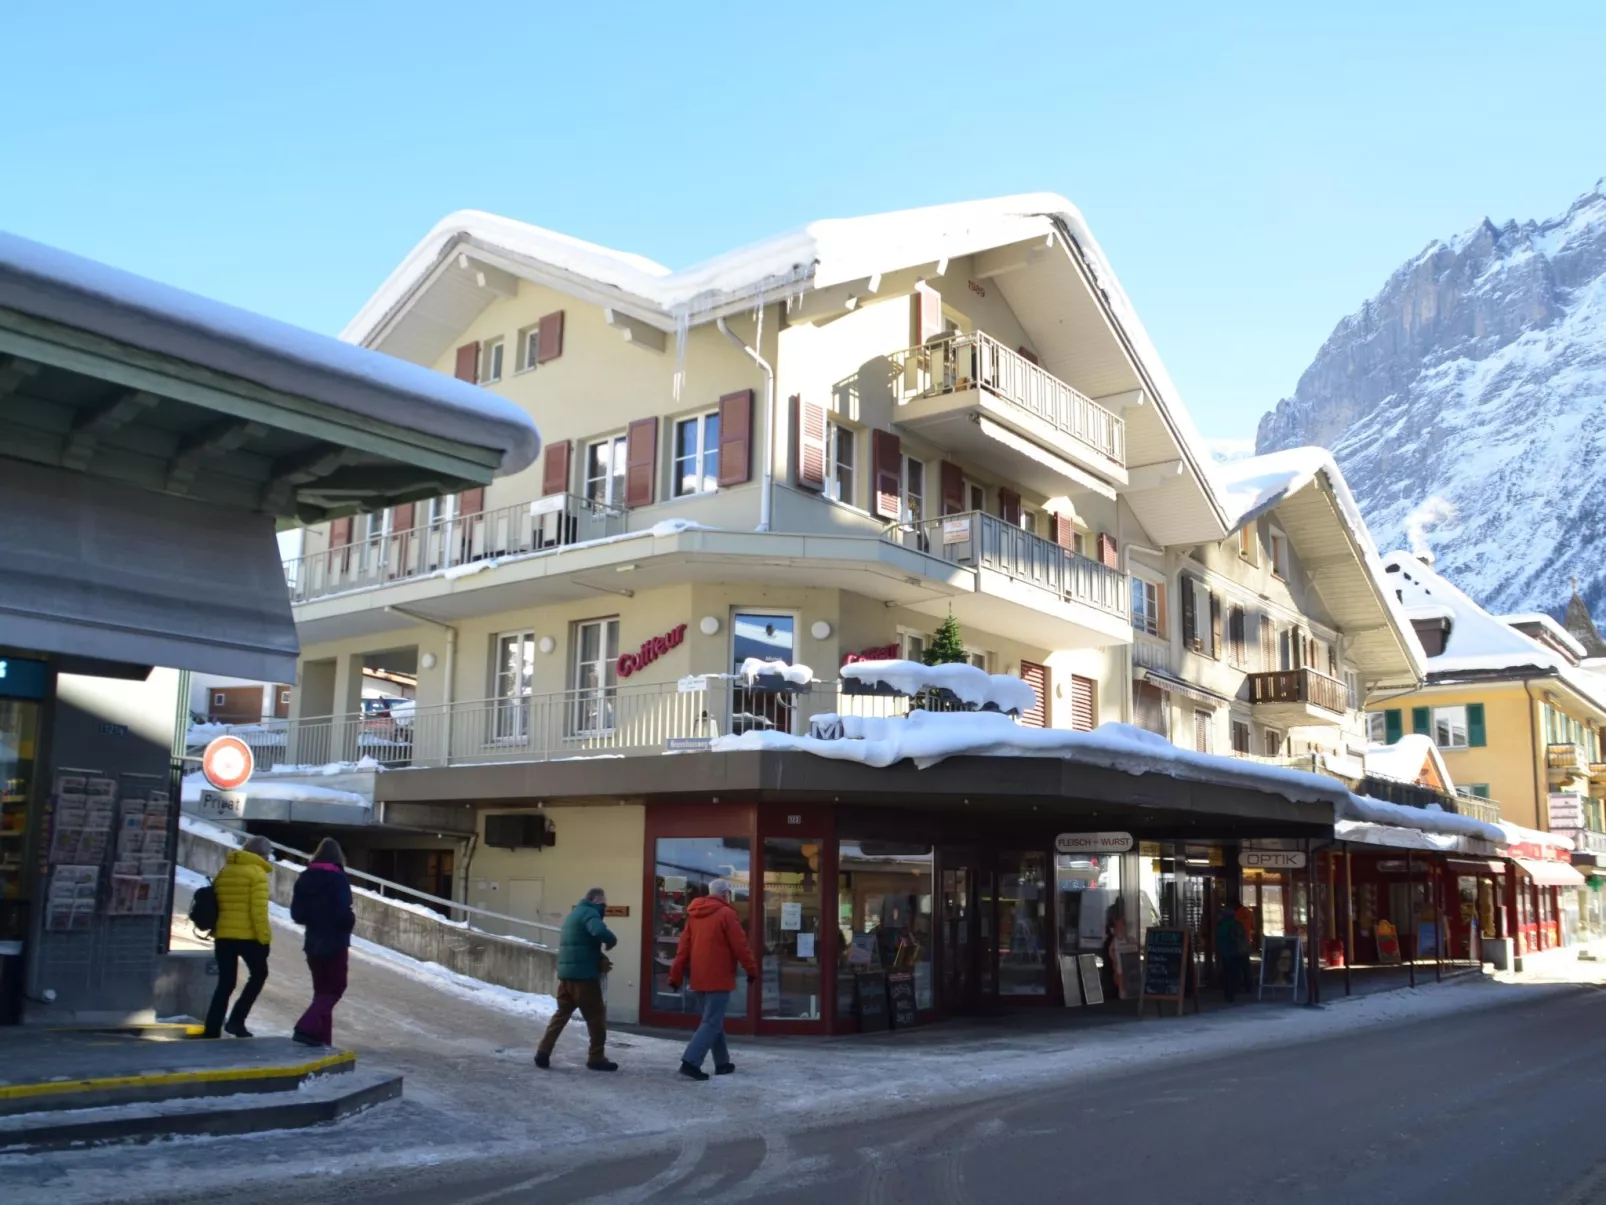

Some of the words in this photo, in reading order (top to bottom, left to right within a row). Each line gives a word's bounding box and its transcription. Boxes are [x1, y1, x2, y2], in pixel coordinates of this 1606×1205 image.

[616, 623, 688, 678] Coiffeur
[1058, 838, 1091, 848] FLEISCH
[1101, 837, 1131, 847] WURST
[1246, 853, 1298, 865] OPTIK
